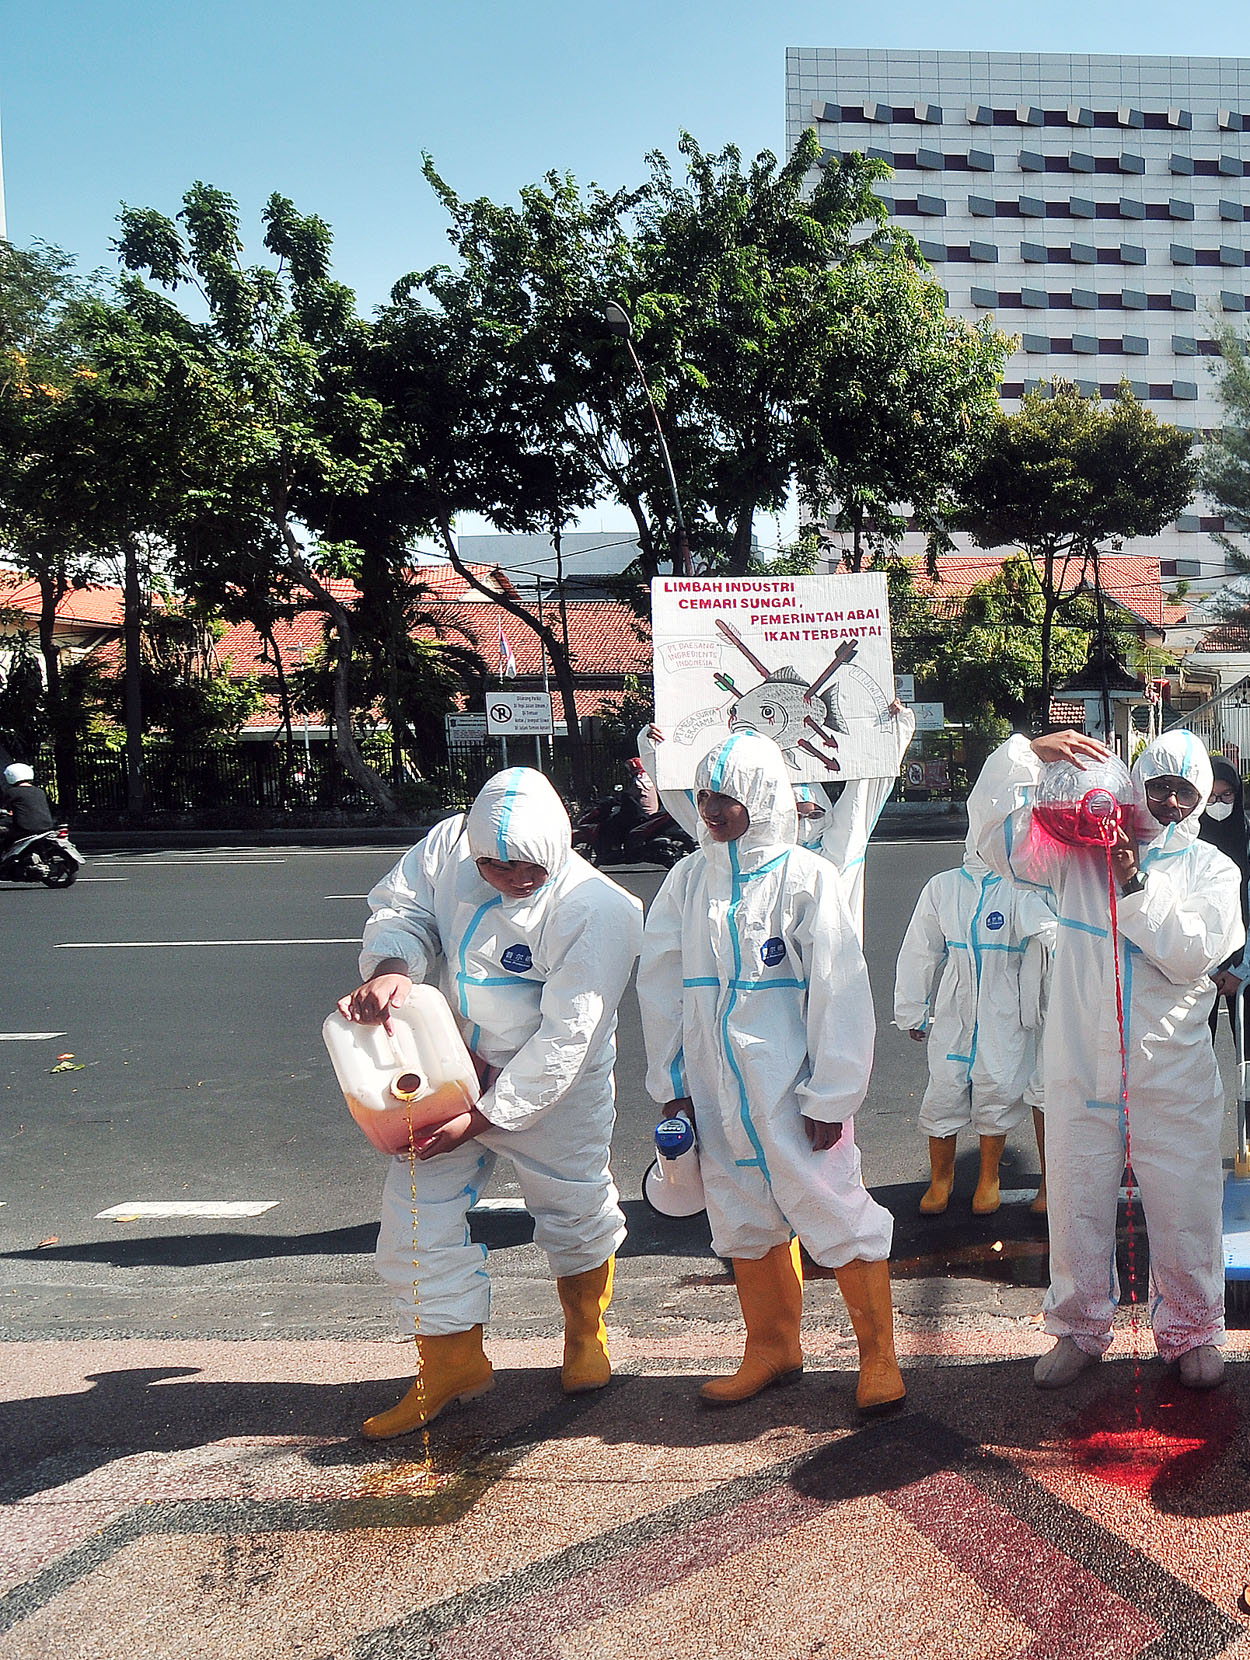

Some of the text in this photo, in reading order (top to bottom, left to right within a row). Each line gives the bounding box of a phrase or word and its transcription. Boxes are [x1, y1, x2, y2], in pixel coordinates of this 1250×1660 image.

[665, 582, 794, 592] LIMBAH INDUSTRI
[679, 599, 736, 609] CEMARI
[751, 609, 879, 624] PEMERINTAH ABAI
[765, 626, 881, 641] IKAN TERBANTAI
[679, 642, 715, 651] DAESANG
